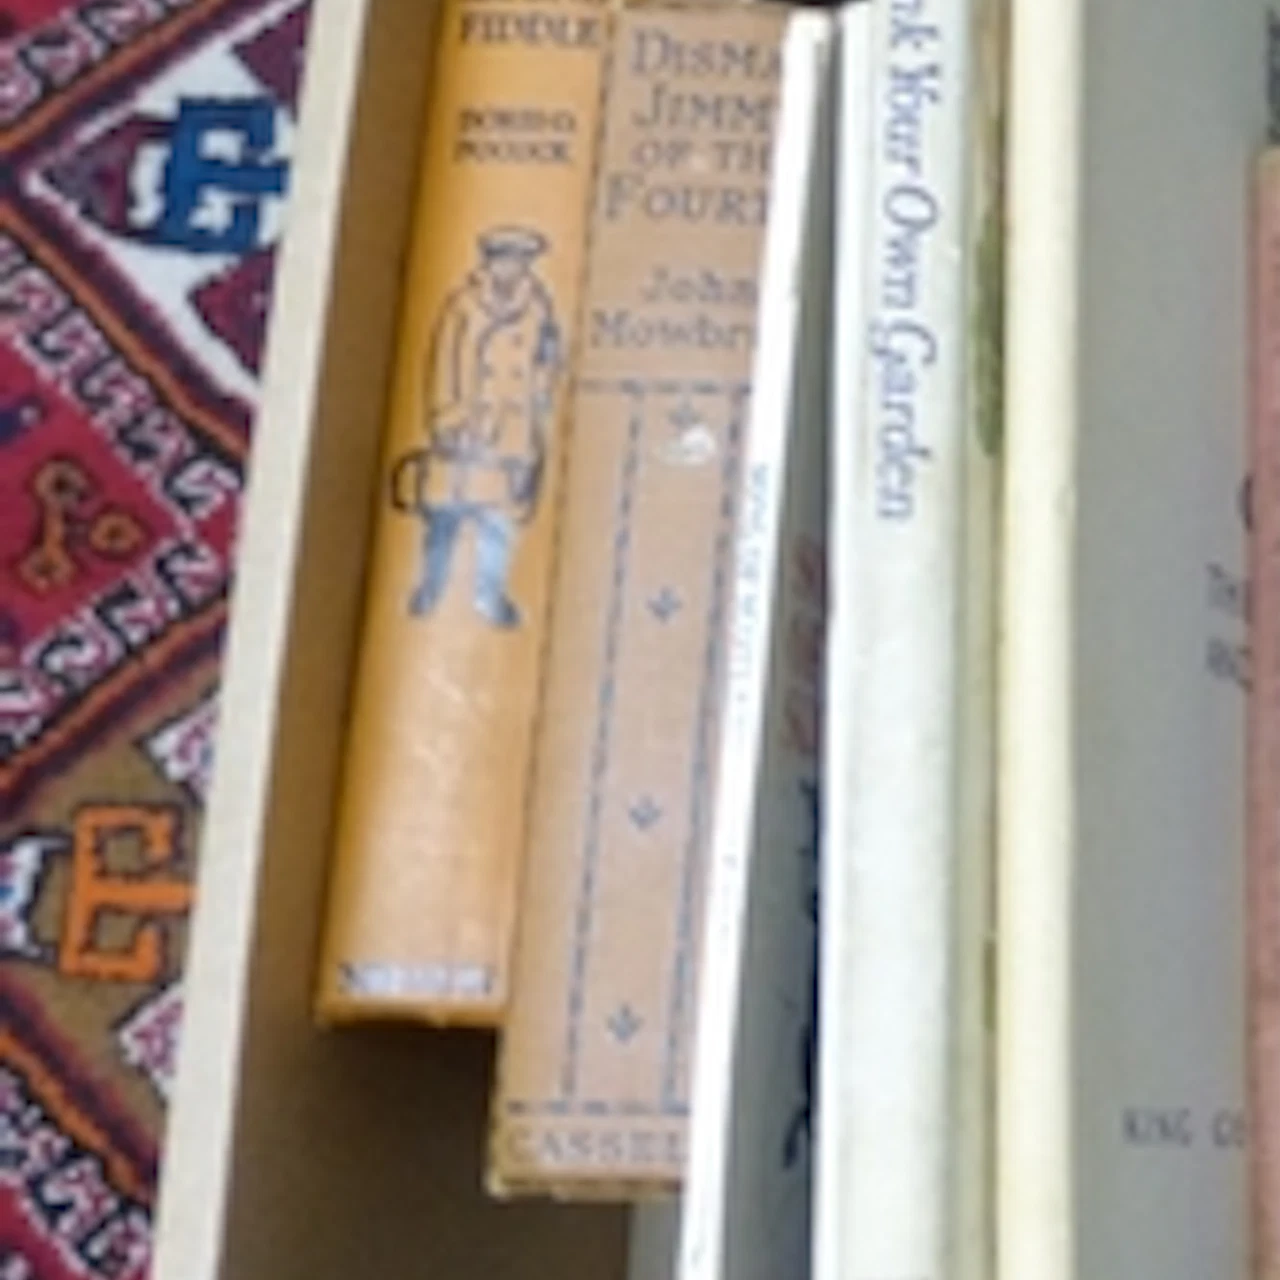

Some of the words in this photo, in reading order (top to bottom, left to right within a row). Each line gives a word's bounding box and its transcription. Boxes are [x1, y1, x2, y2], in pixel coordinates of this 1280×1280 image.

[459, 12, 600, 47] FIDDLE
[630, 28, 783, 80] DISMA
[631, 82, 778, 130] JIMM
[880, 62, 943, 187] Your
[712, 139, 775, 173] TH
[603, 171, 769, 222] FOURT
[880, 192, 940, 313] Own
[871, 322, 936, 523] Garden
[505, 1125, 690, 1164] CASSEL
